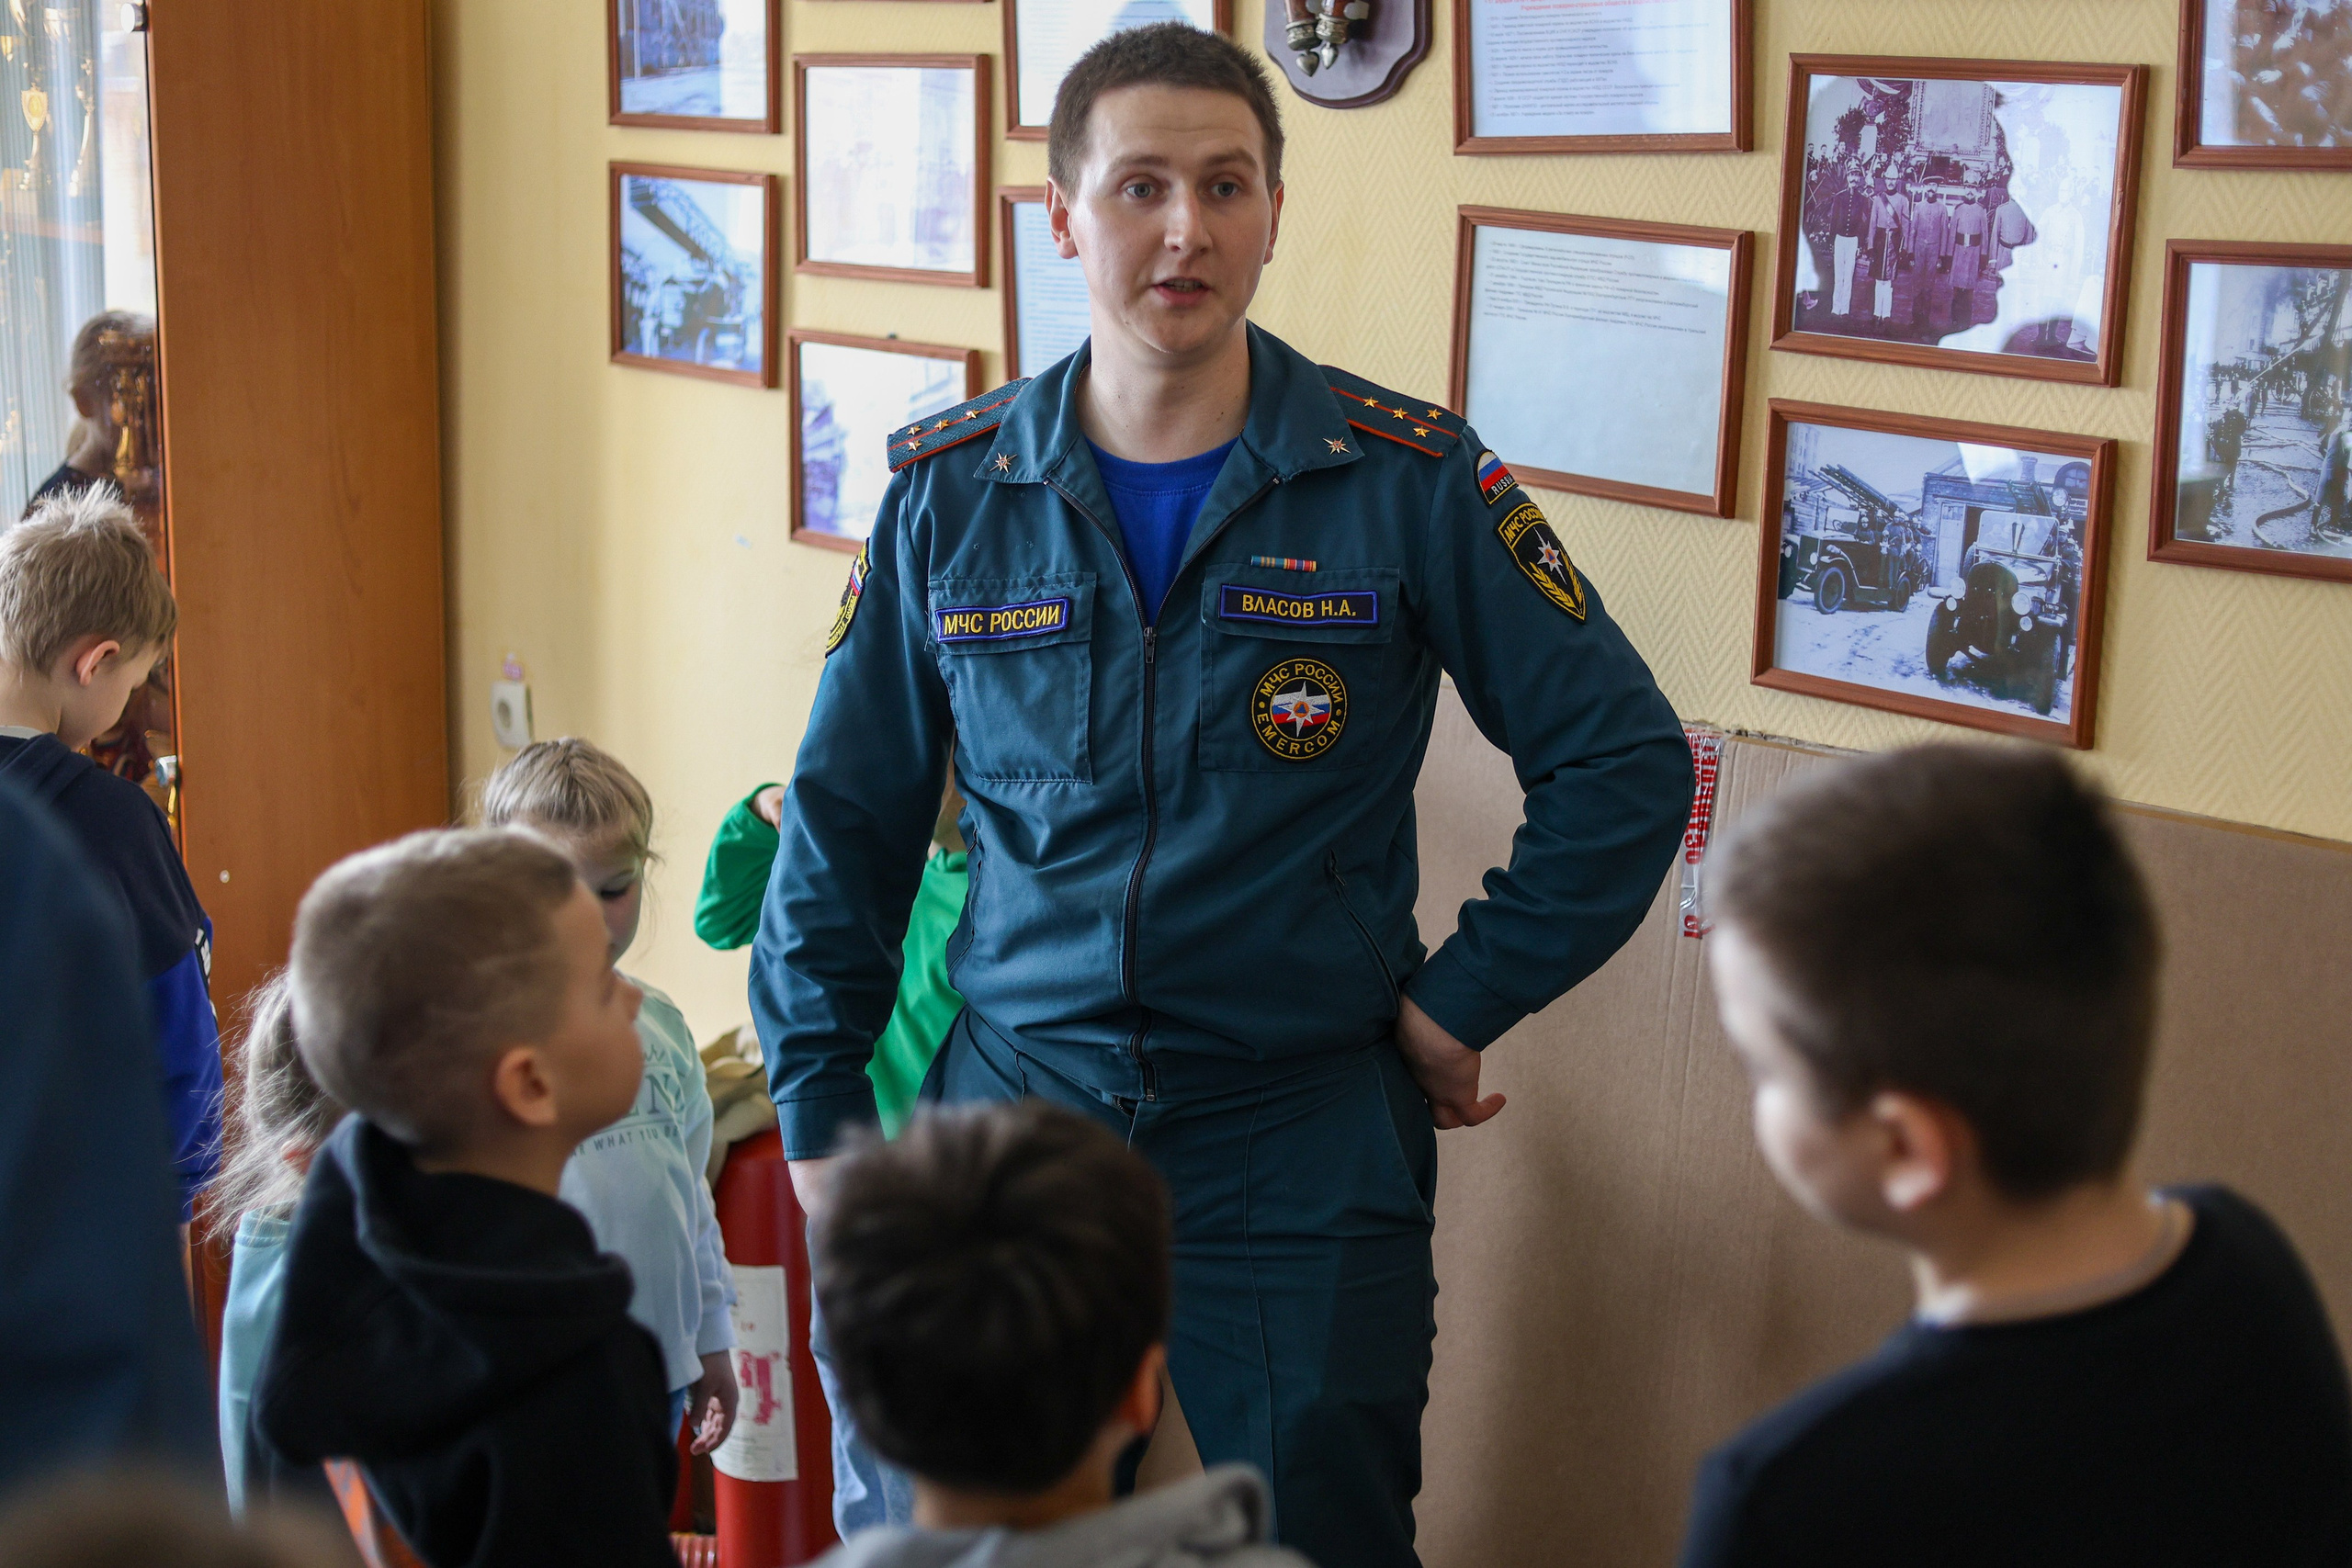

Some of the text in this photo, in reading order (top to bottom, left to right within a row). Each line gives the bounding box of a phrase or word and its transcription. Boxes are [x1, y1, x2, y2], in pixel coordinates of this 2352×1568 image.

[1504, 507, 1546, 544] МЧС РОСС
[944, 604, 1061, 636] МЧС РОССИИ
[1242, 593, 1357, 618] ВЛАСОВ Н.А.
[1260, 663, 1343, 704] МЧС РОССИИ
[1257, 713, 1340, 754] EMERCOM
[594, 1131, 633, 1151] WHAT
